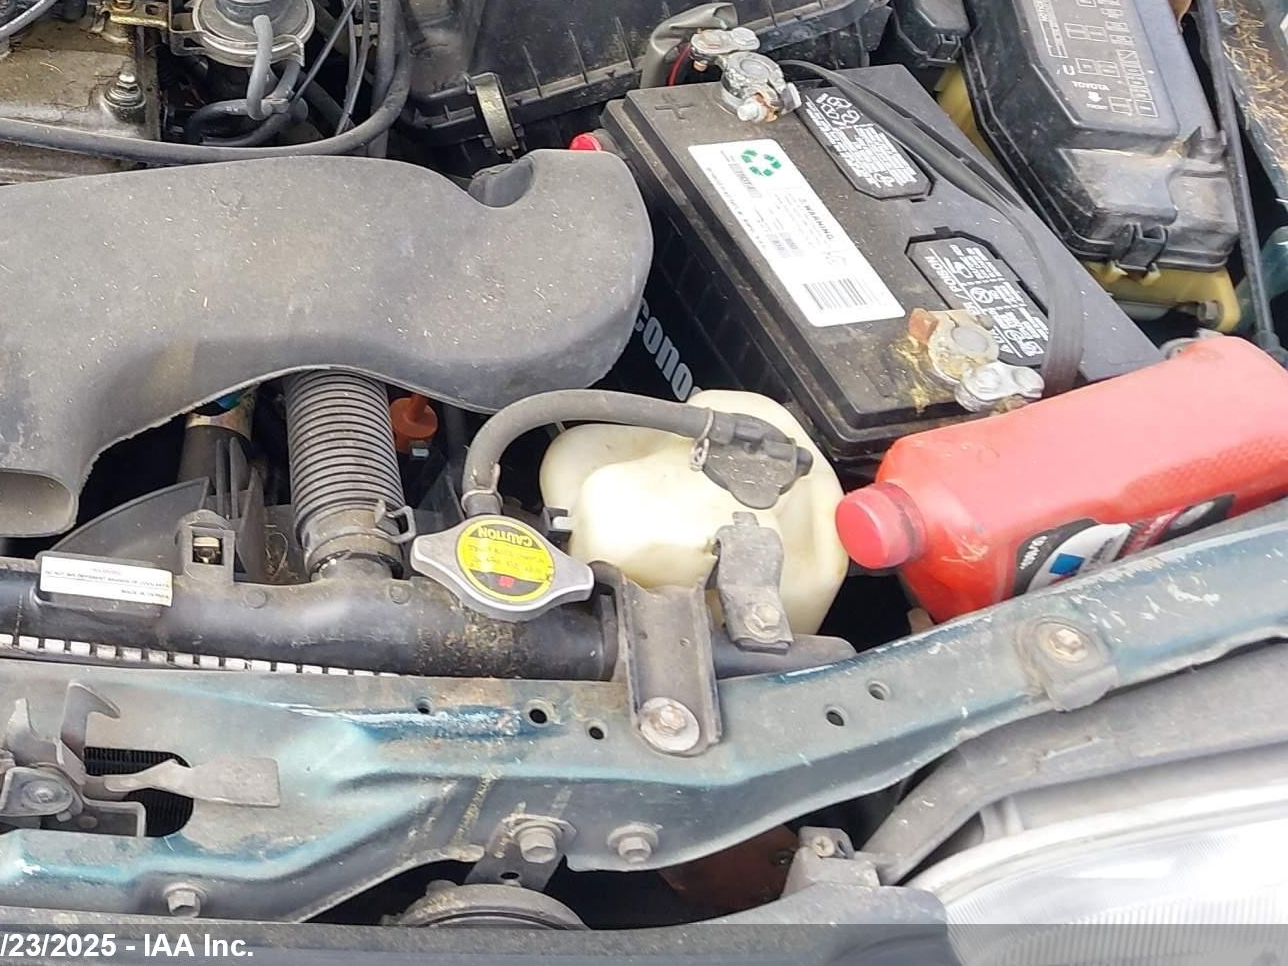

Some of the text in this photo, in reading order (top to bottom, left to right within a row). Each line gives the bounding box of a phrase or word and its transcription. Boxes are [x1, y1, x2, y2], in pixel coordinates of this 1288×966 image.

[1071, 81, 1110, 91] TOYOTA
[924, 255, 963, 297] POISON
[478, 525, 533, 548] CAUTION
